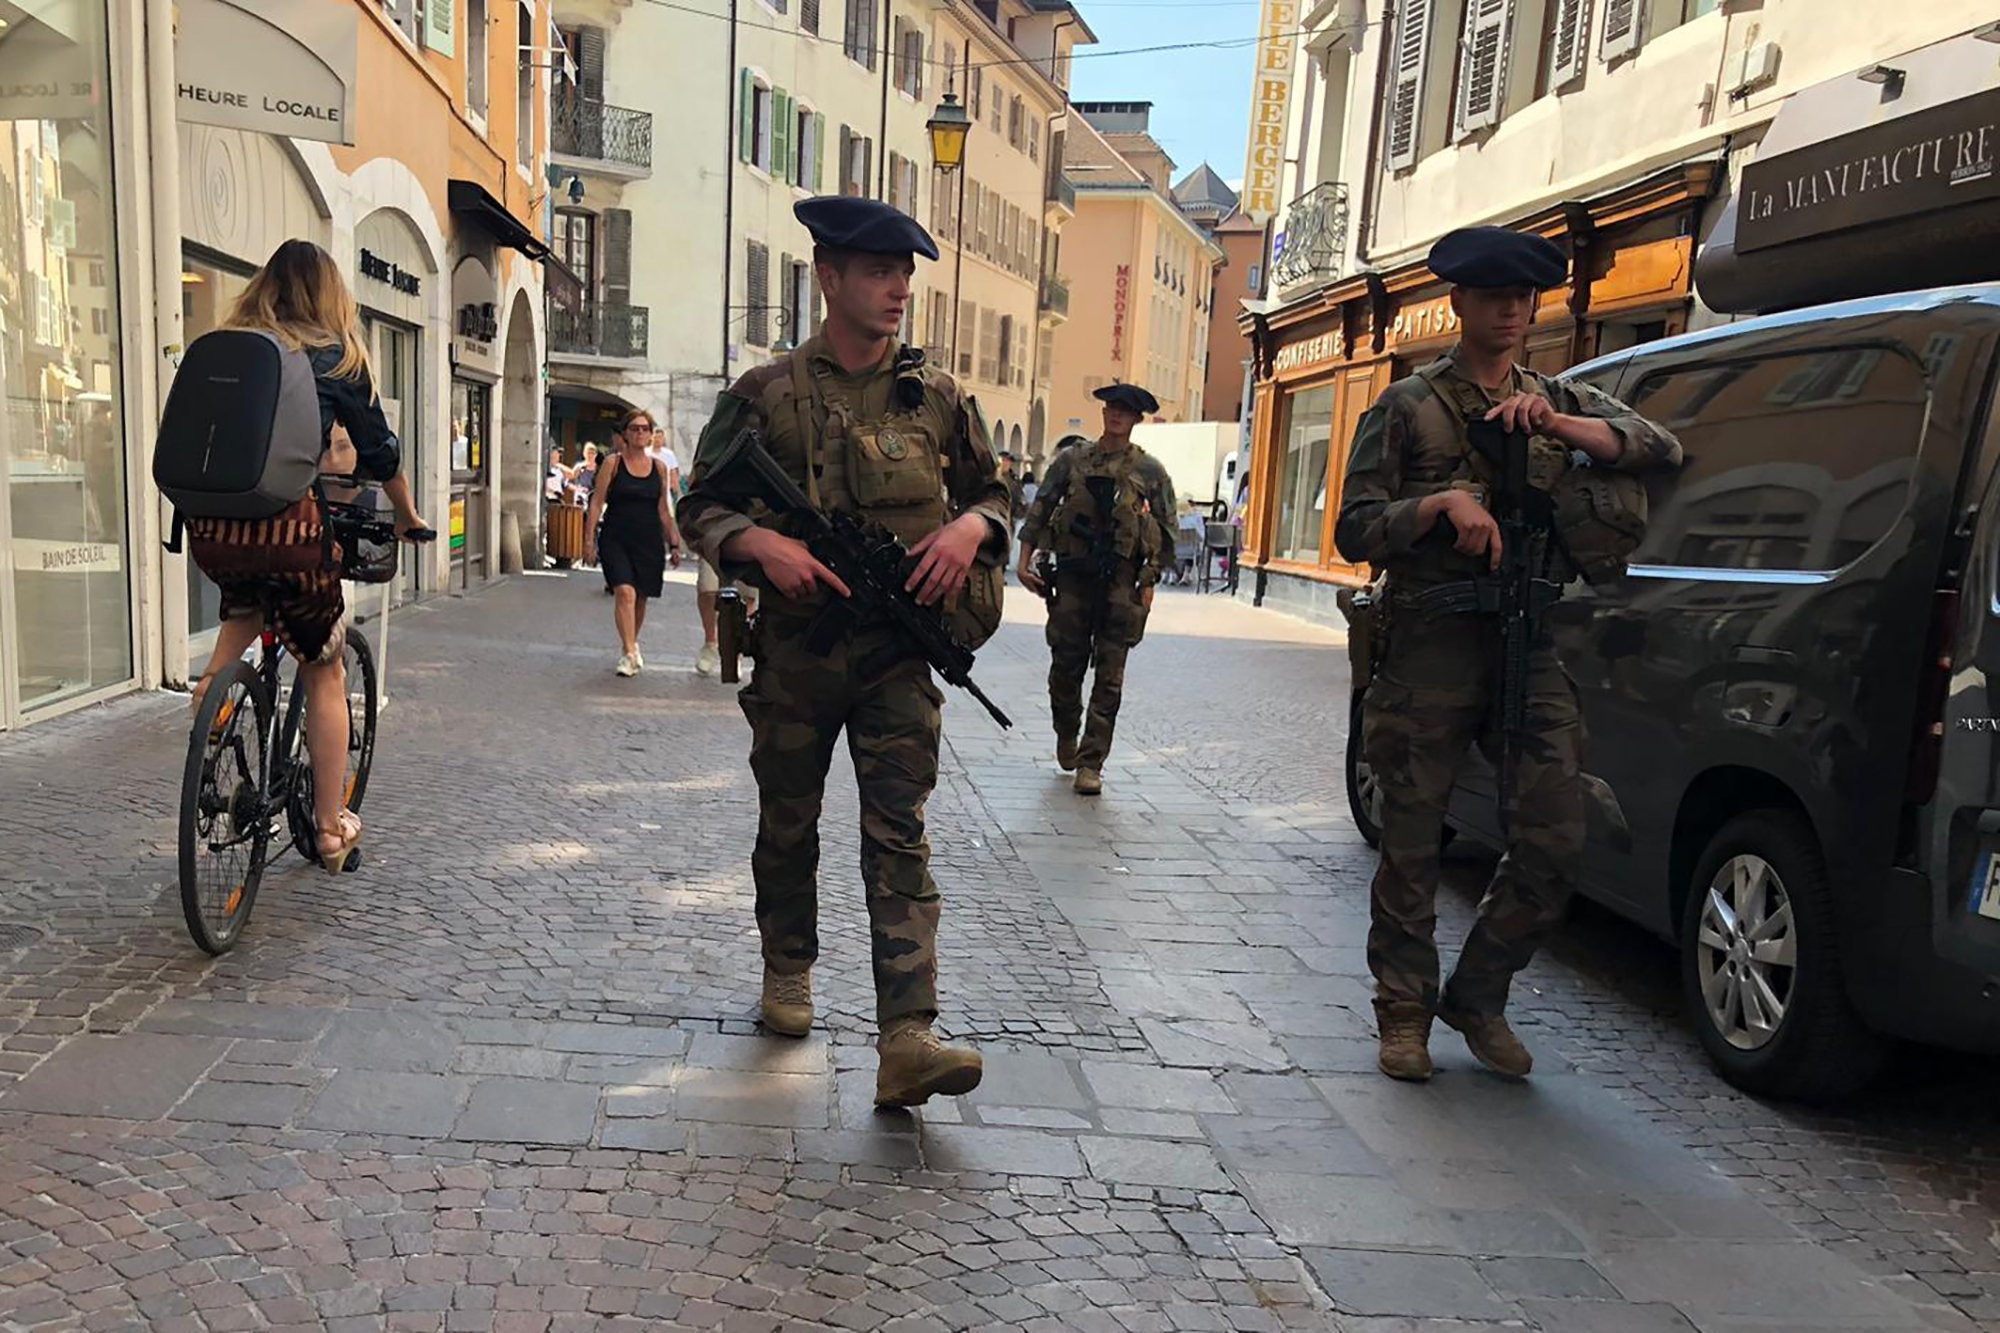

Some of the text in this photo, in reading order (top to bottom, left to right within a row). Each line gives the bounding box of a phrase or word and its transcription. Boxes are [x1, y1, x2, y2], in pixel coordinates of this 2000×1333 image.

[178, 82, 339, 122] HEURE LOCALE
[1251, 80, 1286, 211] BERGER
[1749, 124, 1995, 220] La MANUFACTURE
[1110, 264, 1129, 361] MONOPRIX
[1393, 303, 1457, 339] PATISS
[1276, 327, 1343, 371] CONFISERIE
